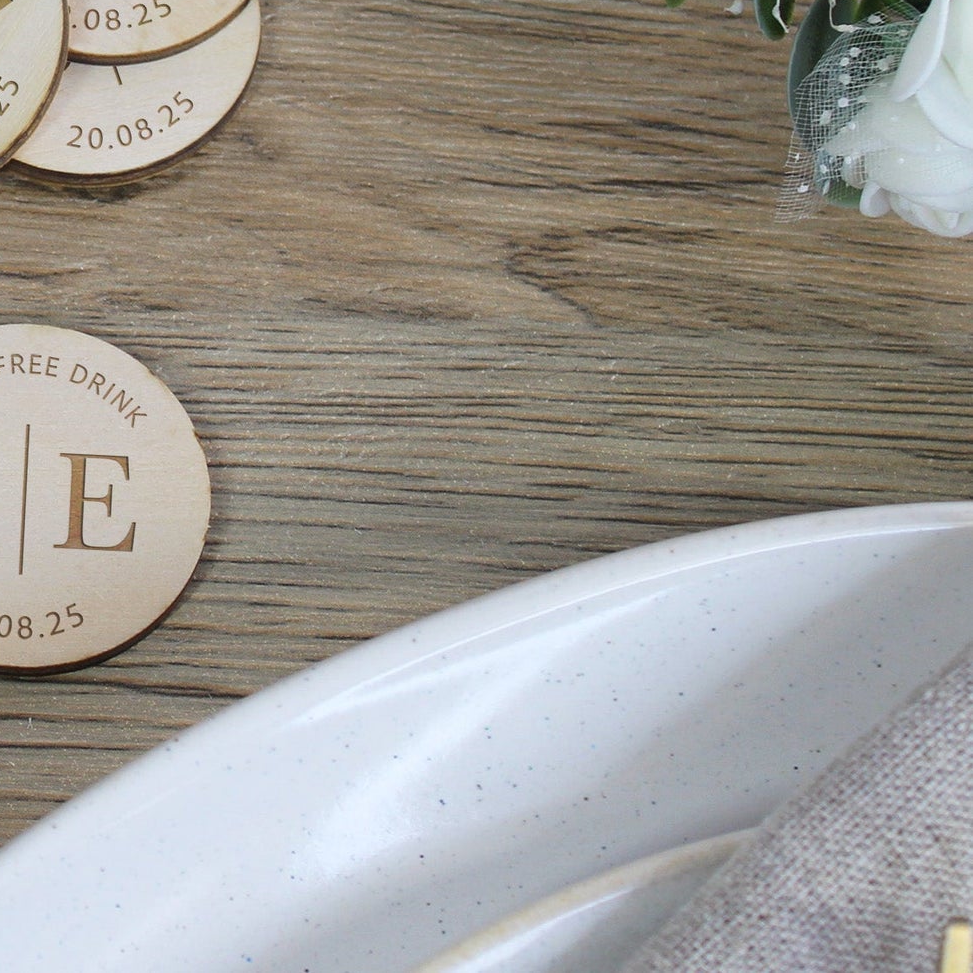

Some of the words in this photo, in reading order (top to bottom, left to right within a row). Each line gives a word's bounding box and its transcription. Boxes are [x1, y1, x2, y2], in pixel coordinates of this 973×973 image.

[65, 90, 196, 151] 20.08.25
[69, 363, 148, 428] DRINK
[53, 452, 137, 553] E
